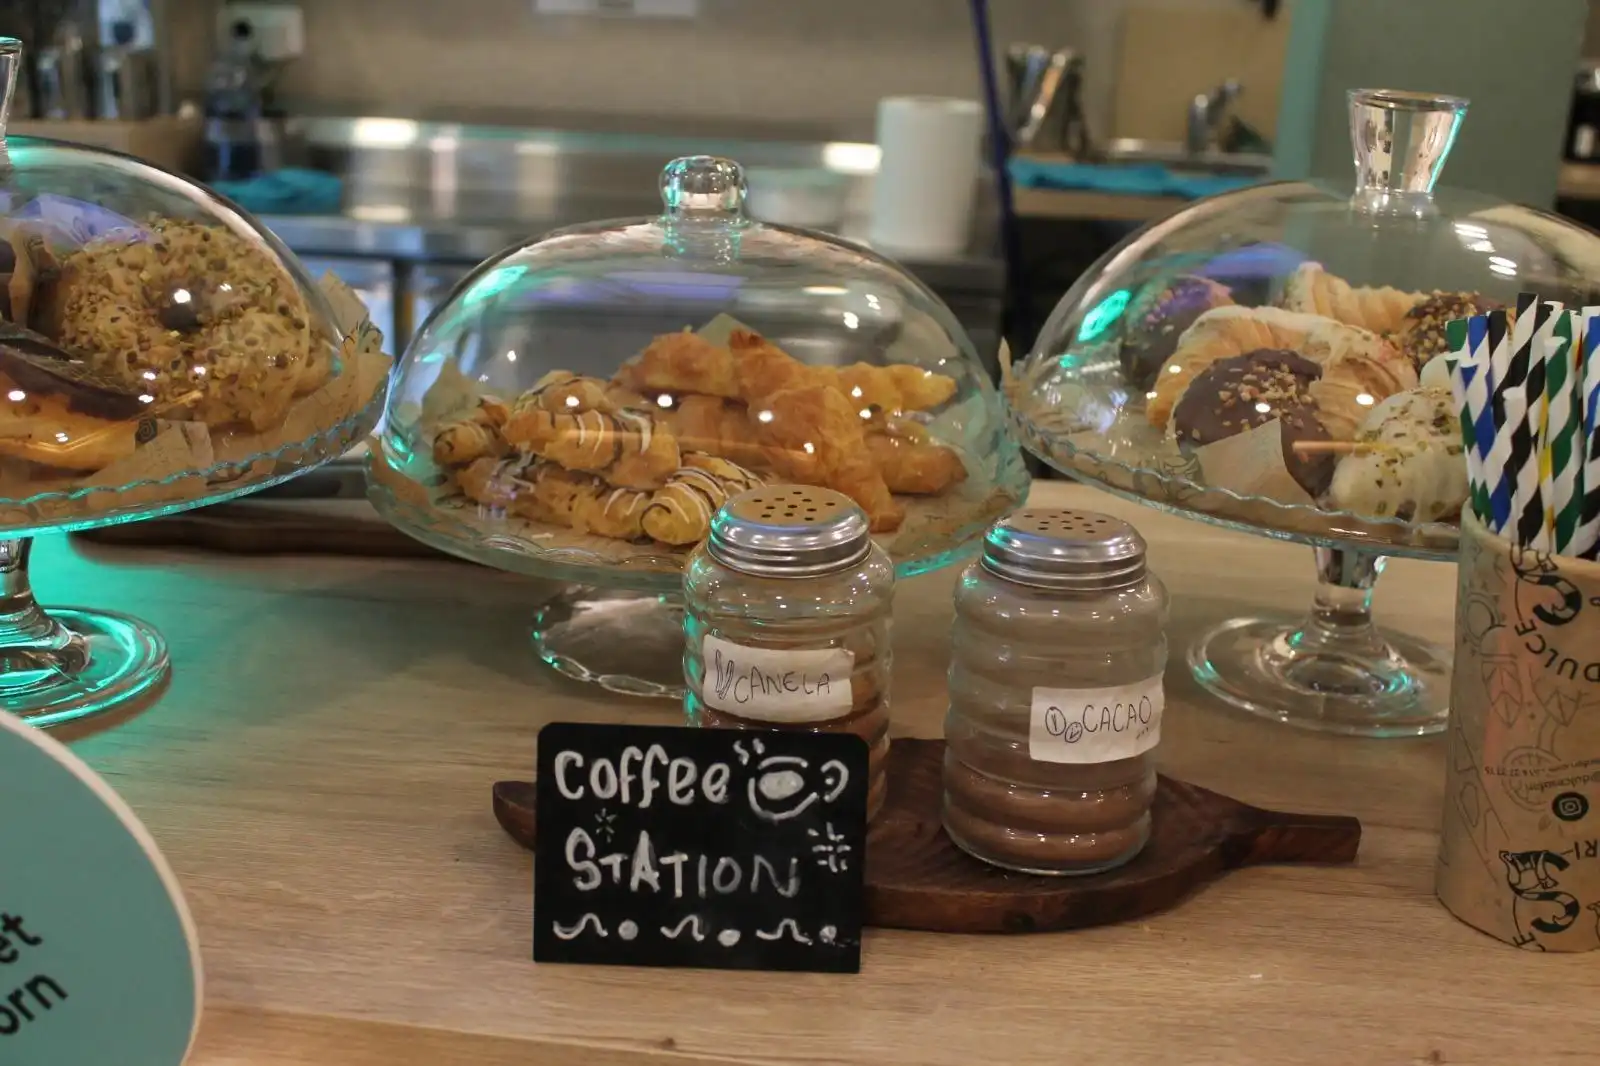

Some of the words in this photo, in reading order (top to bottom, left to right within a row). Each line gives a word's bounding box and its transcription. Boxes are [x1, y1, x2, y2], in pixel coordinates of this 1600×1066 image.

[1514, 619, 1600, 682] DULCE
[733, 666, 830, 703] CANELA
[1083, 696, 1152, 732] CACAO
[554, 744, 731, 808] Coffee
[566, 827, 800, 898] STATION
